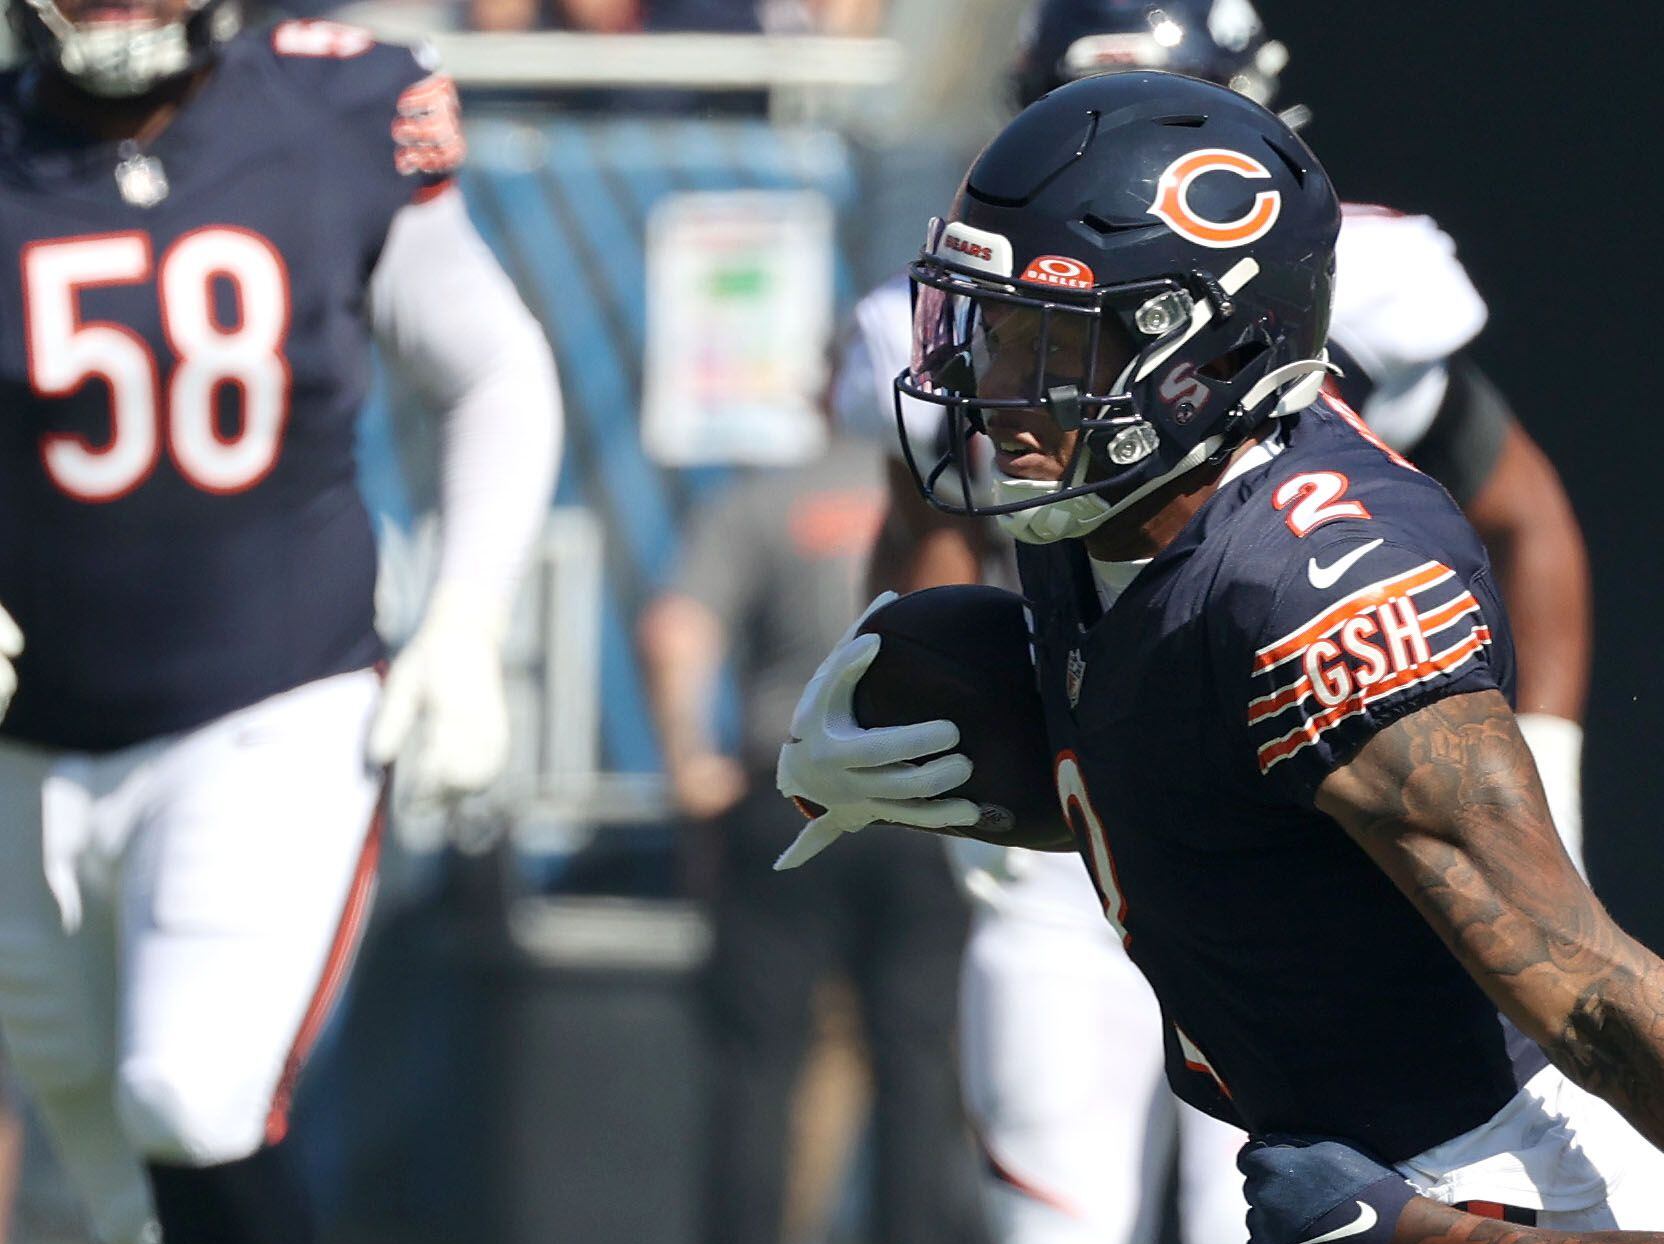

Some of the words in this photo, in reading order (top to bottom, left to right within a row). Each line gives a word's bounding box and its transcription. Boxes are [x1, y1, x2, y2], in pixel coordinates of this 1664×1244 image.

[944, 234, 993, 262] BEARS
[1027, 269, 1090, 289] OAKLEY
[22, 222, 291, 503] 58
[1272, 470, 1373, 538] 2
[1302, 595, 1431, 708] GSH
